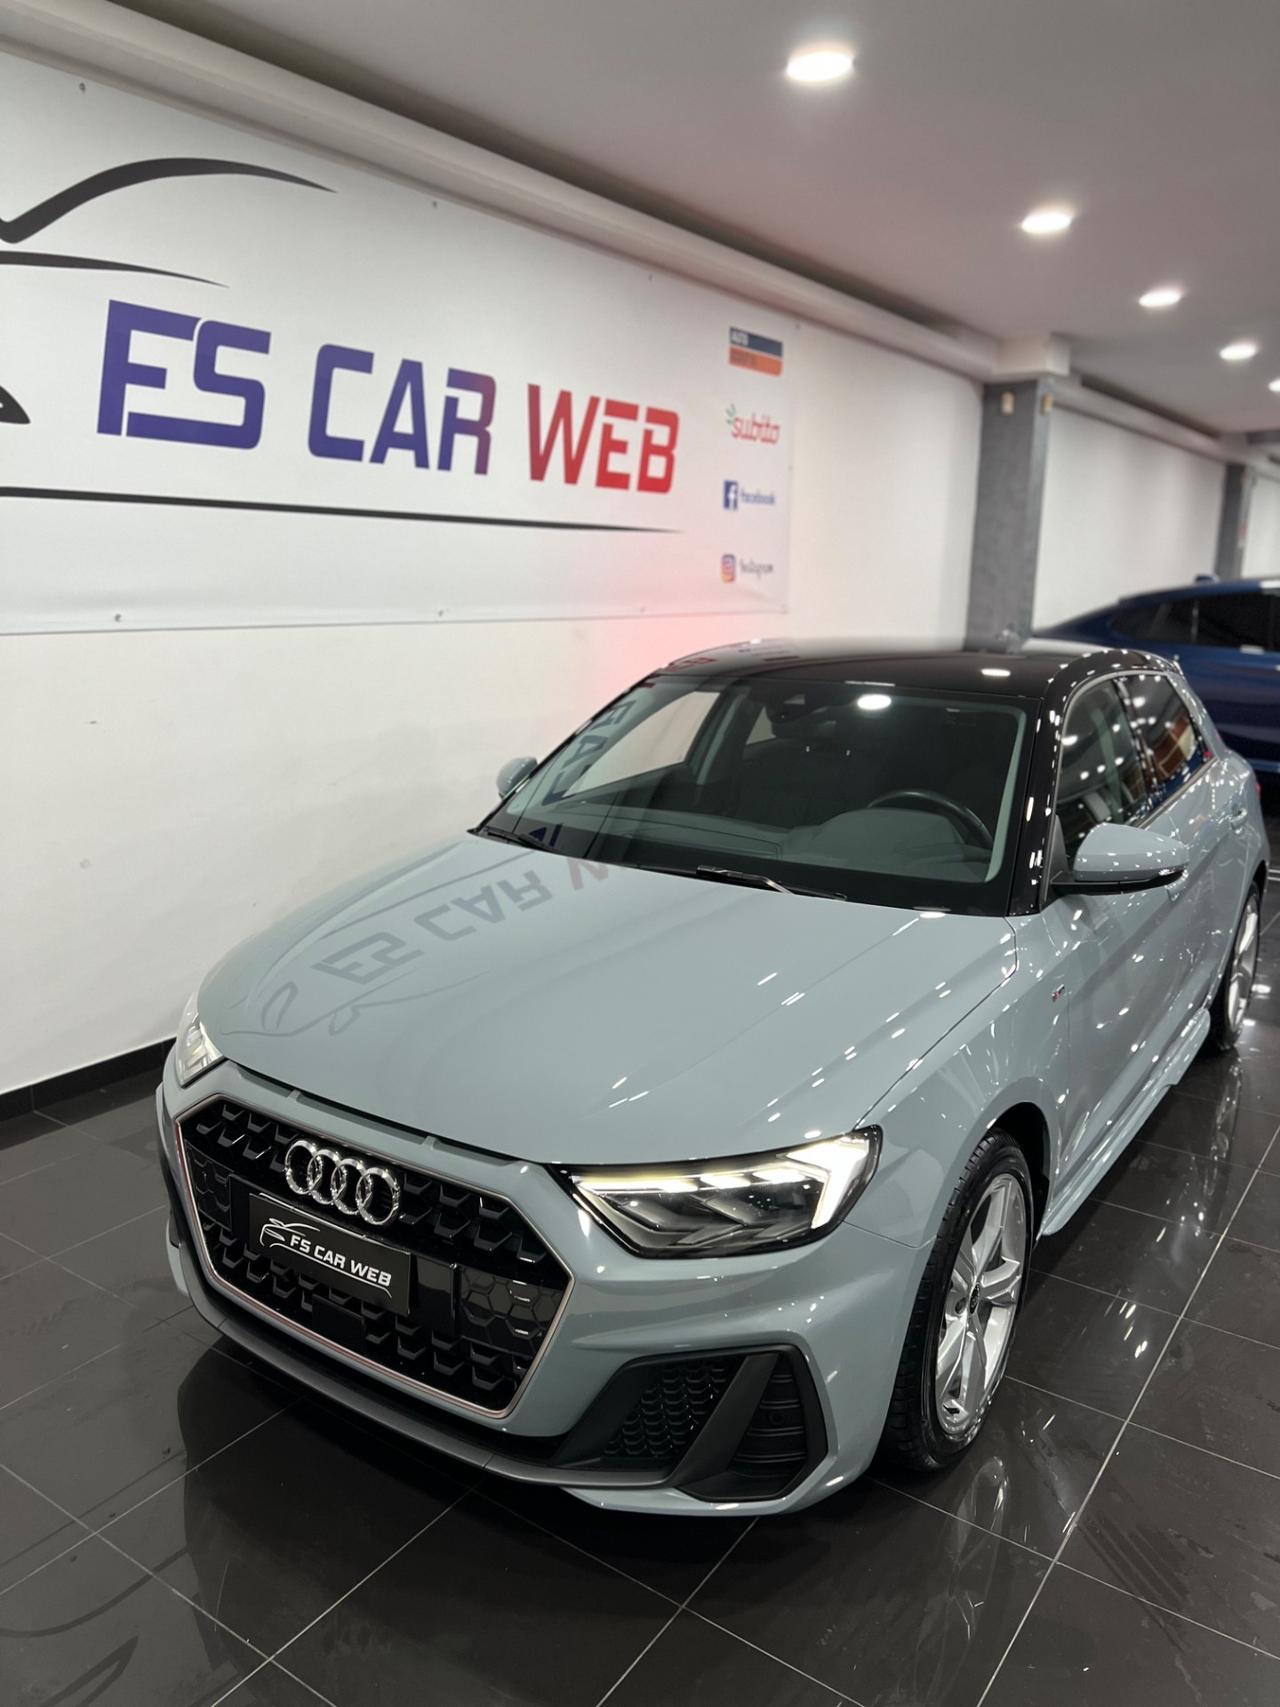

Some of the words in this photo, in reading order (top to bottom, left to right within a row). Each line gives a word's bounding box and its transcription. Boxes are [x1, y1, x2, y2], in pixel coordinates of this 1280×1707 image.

[308, 344, 496, 475] CAR
[526, 384, 680, 494] WEB
[731, 411, 780, 445] subito
[290, 1234, 312, 1253] FS
[314, 1245, 346, 1269] CAR
[350, 1259, 392, 1287] WEB
